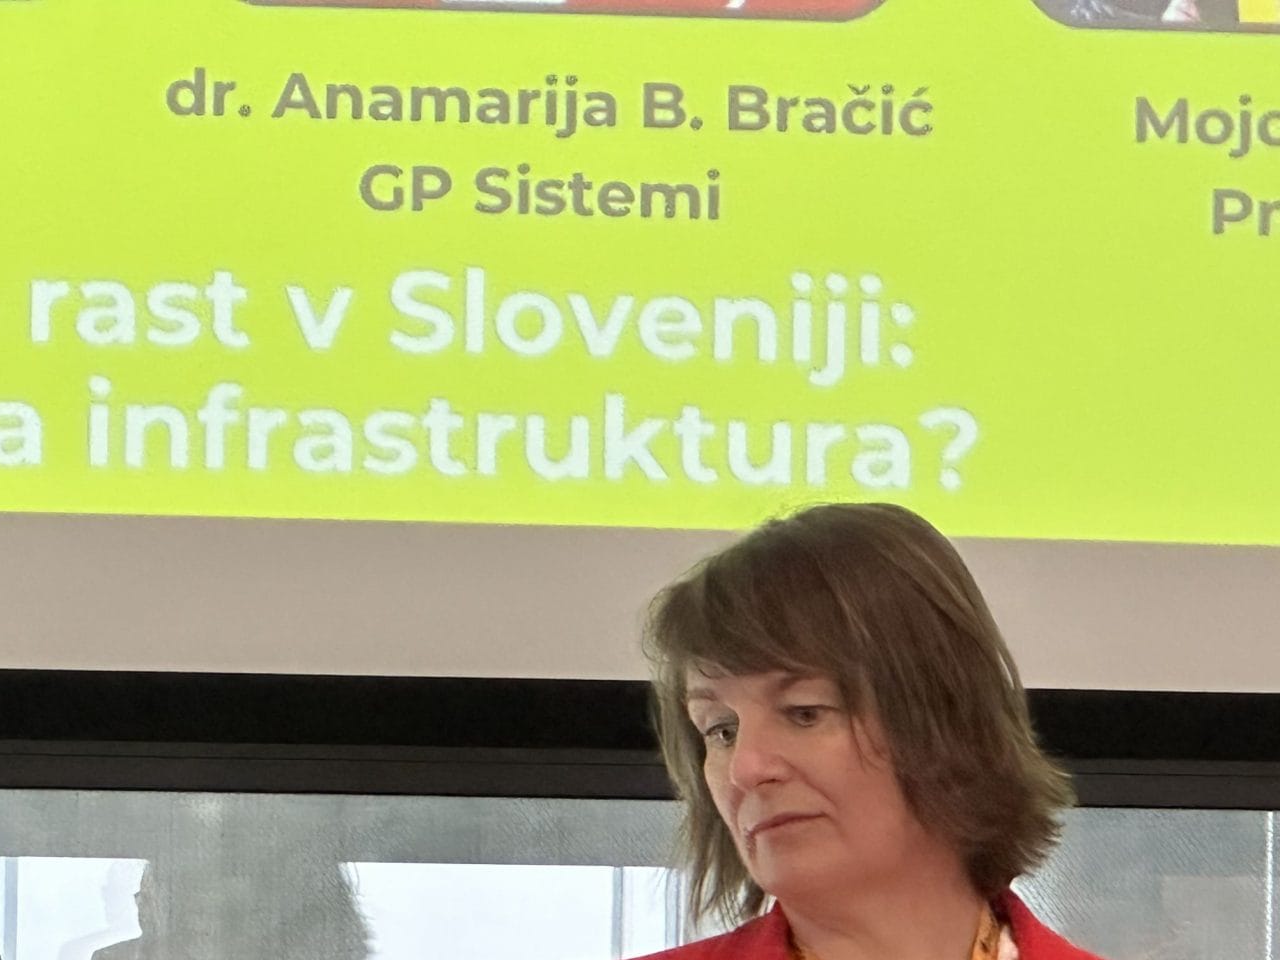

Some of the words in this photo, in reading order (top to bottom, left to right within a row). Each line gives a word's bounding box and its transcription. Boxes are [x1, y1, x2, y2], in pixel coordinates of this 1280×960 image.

[166, 68, 252, 118] dr.
[271, 73, 617, 138] Anamarija
[643, 83, 704, 131] B.
[728, 84, 934, 136] Bračić
[359, 164, 453, 212] GP
[474, 163, 720, 221] Sistemi
[30, 271, 250, 349] rast
[285, 286, 354, 350] v
[389, 267, 916, 388] Sloveniji:
[88, 376, 980, 492] infrastruktura?
